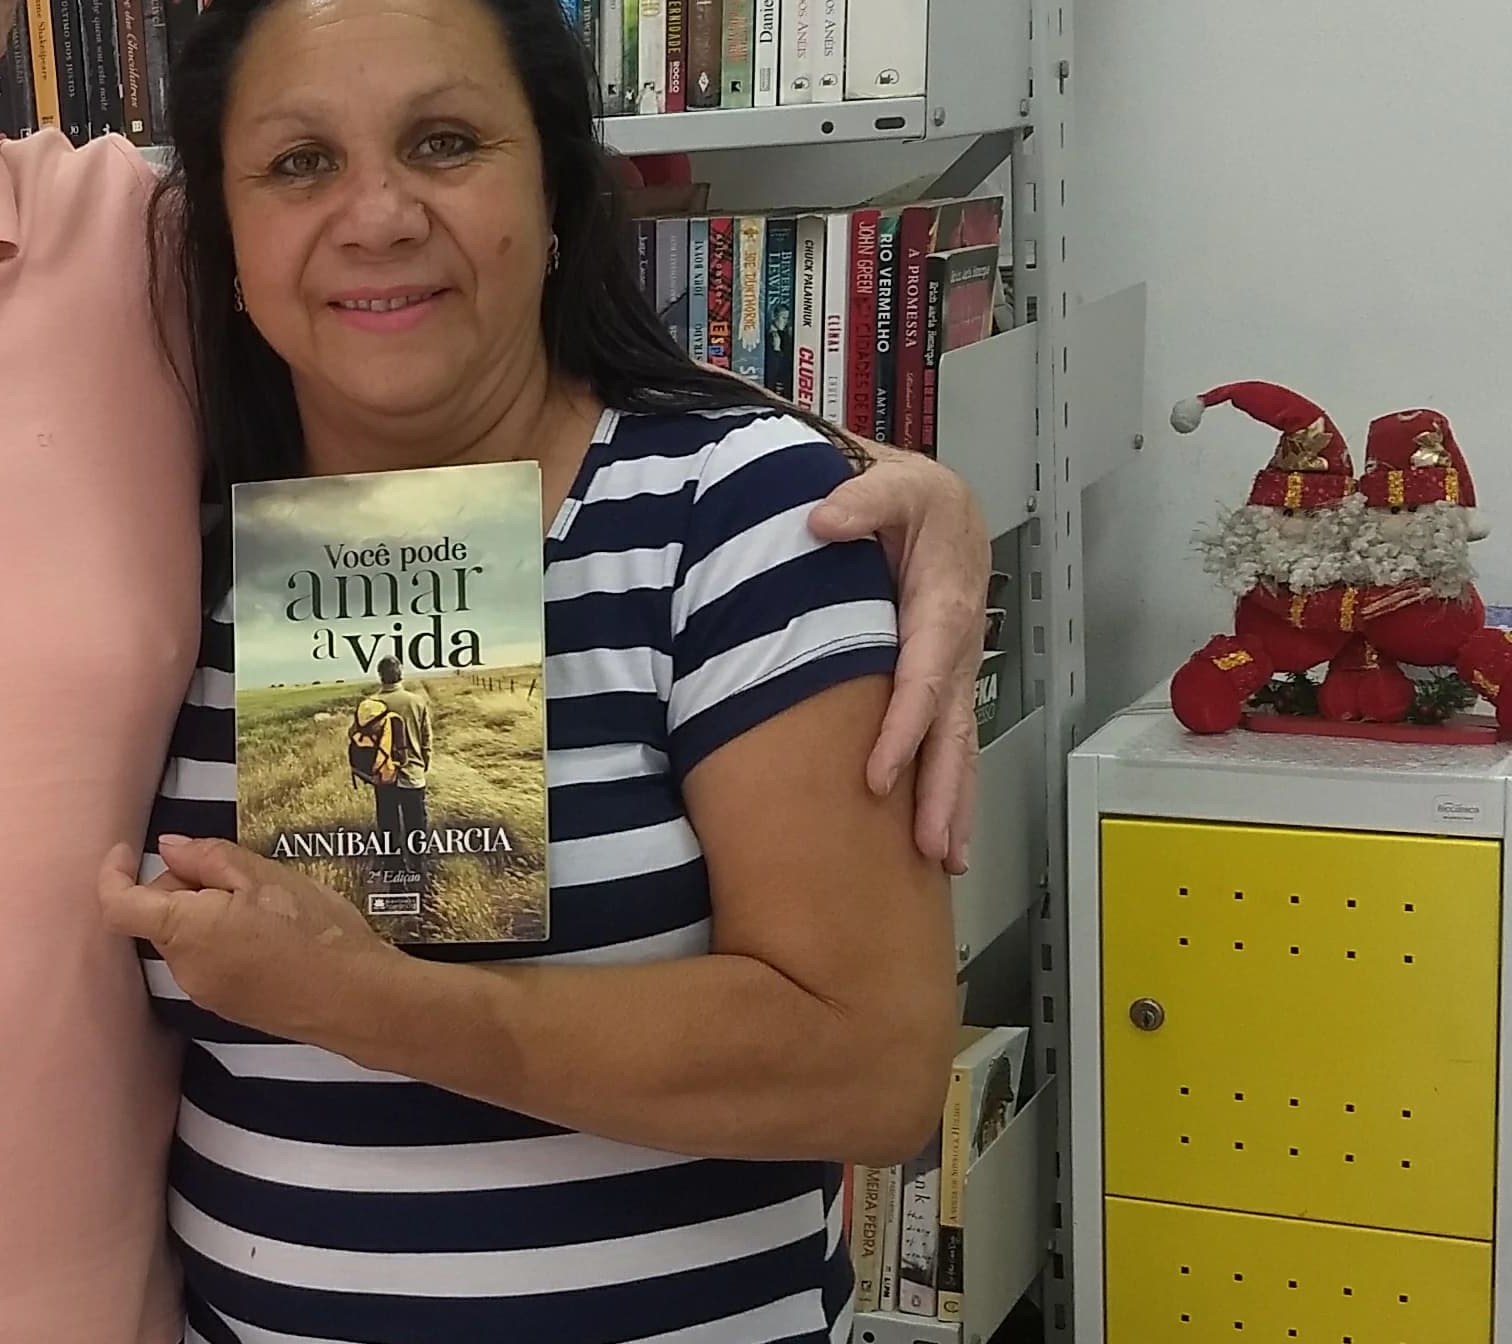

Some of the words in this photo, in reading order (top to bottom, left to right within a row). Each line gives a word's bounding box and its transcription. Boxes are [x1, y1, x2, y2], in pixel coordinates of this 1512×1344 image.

[672, 61, 680, 93] ROCCO
[804, 240, 814, 270] CHUCK
[859, 221, 876, 257] JOHN
[879, 233, 893, 261] RIO
[908, 248, 920, 258] A
[857, 258, 873, 295] GREEN
[802, 272, 813, 328] PALAHNIUK
[877, 265, 892, 354] VERMELHO
[905, 266, 919, 348] PROMESSA
[798, 347, 814, 400] CLUBE
[324, 543, 391, 569] Você
[400, 537, 467, 572] pode
[286, 565, 483, 622] amar
[312, 628, 338, 660] a
[342, 615, 483, 674] vida
[272, 826, 401, 858] ANNÍBAL
[407, 828, 513, 854] GARCIA
